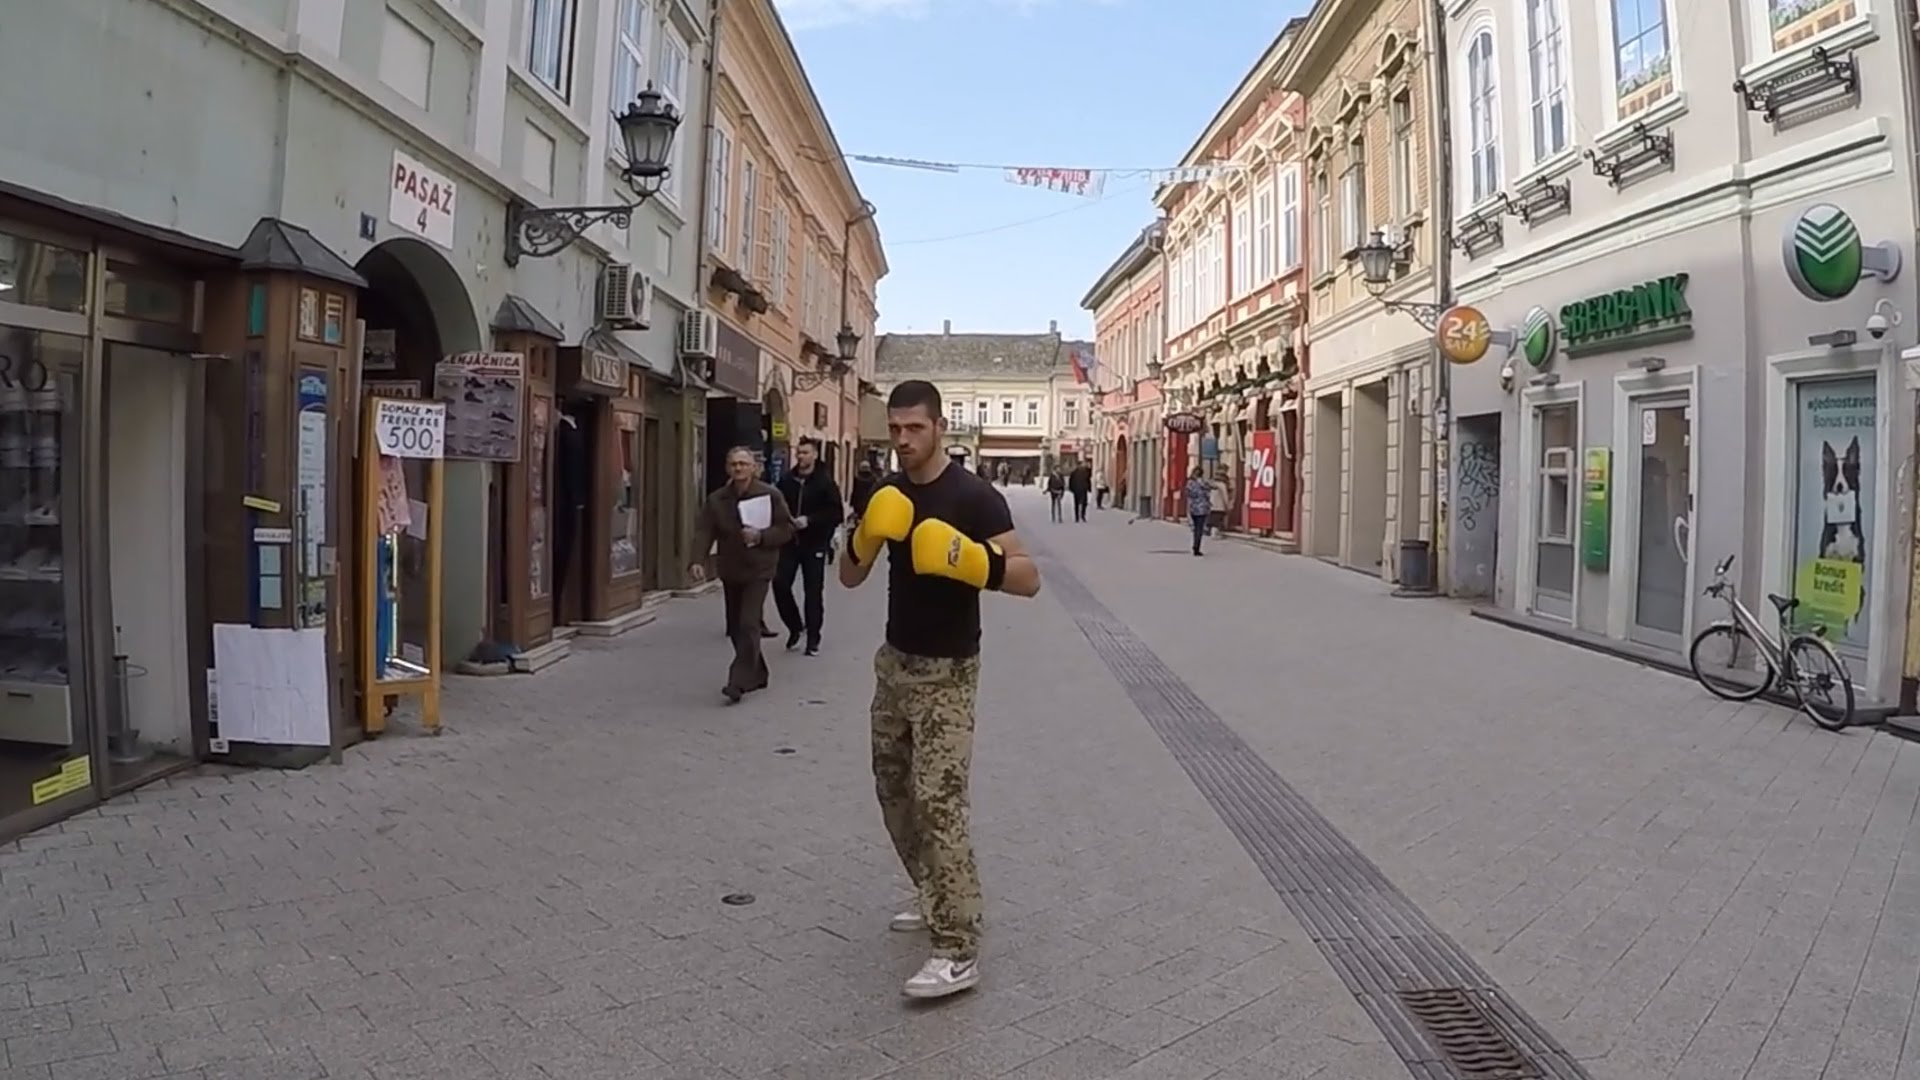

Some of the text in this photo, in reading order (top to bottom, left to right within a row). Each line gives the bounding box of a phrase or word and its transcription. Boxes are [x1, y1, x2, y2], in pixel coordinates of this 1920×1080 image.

[395, 163, 453, 215] PASAŽ
[417, 207, 428, 233] 4
[1560, 273, 1691, 340] SBERBANK
[1447, 316, 1477, 341] 24
[443, 352, 520, 367] ENJAČNICA
[1814, 562, 1847, 579] Bonus
[1813, 577, 1846, 595] kredit
